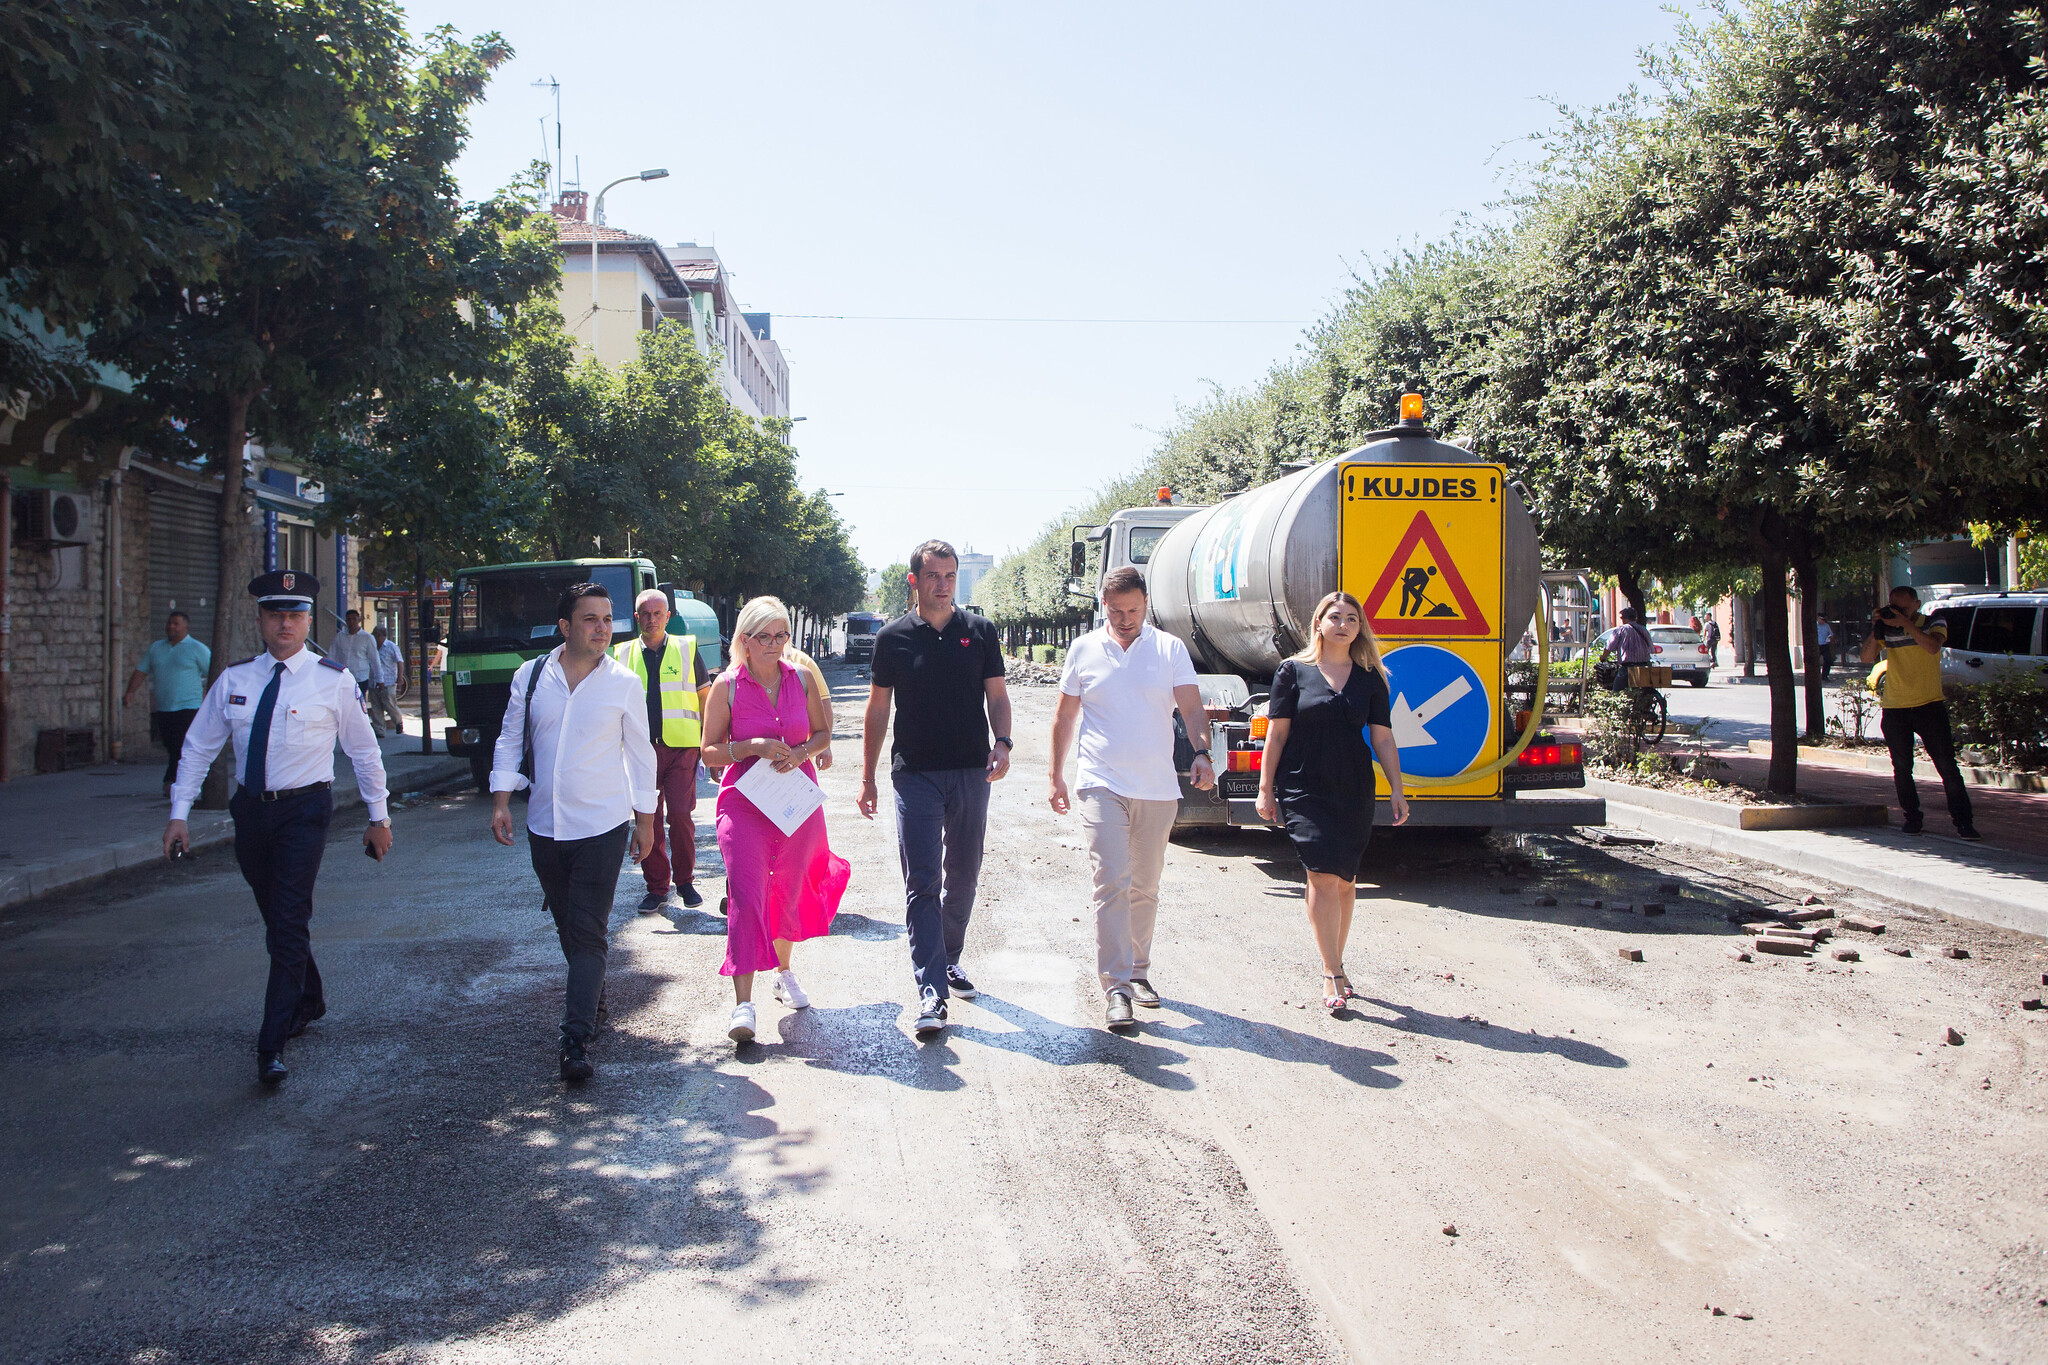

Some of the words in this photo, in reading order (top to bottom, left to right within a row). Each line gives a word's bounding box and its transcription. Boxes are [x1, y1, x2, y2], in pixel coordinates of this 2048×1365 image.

[1348, 475, 1354, 501] !
[1363, 477, 1477, 498] KUJDES
[1490, 477, 1496, 503] !
